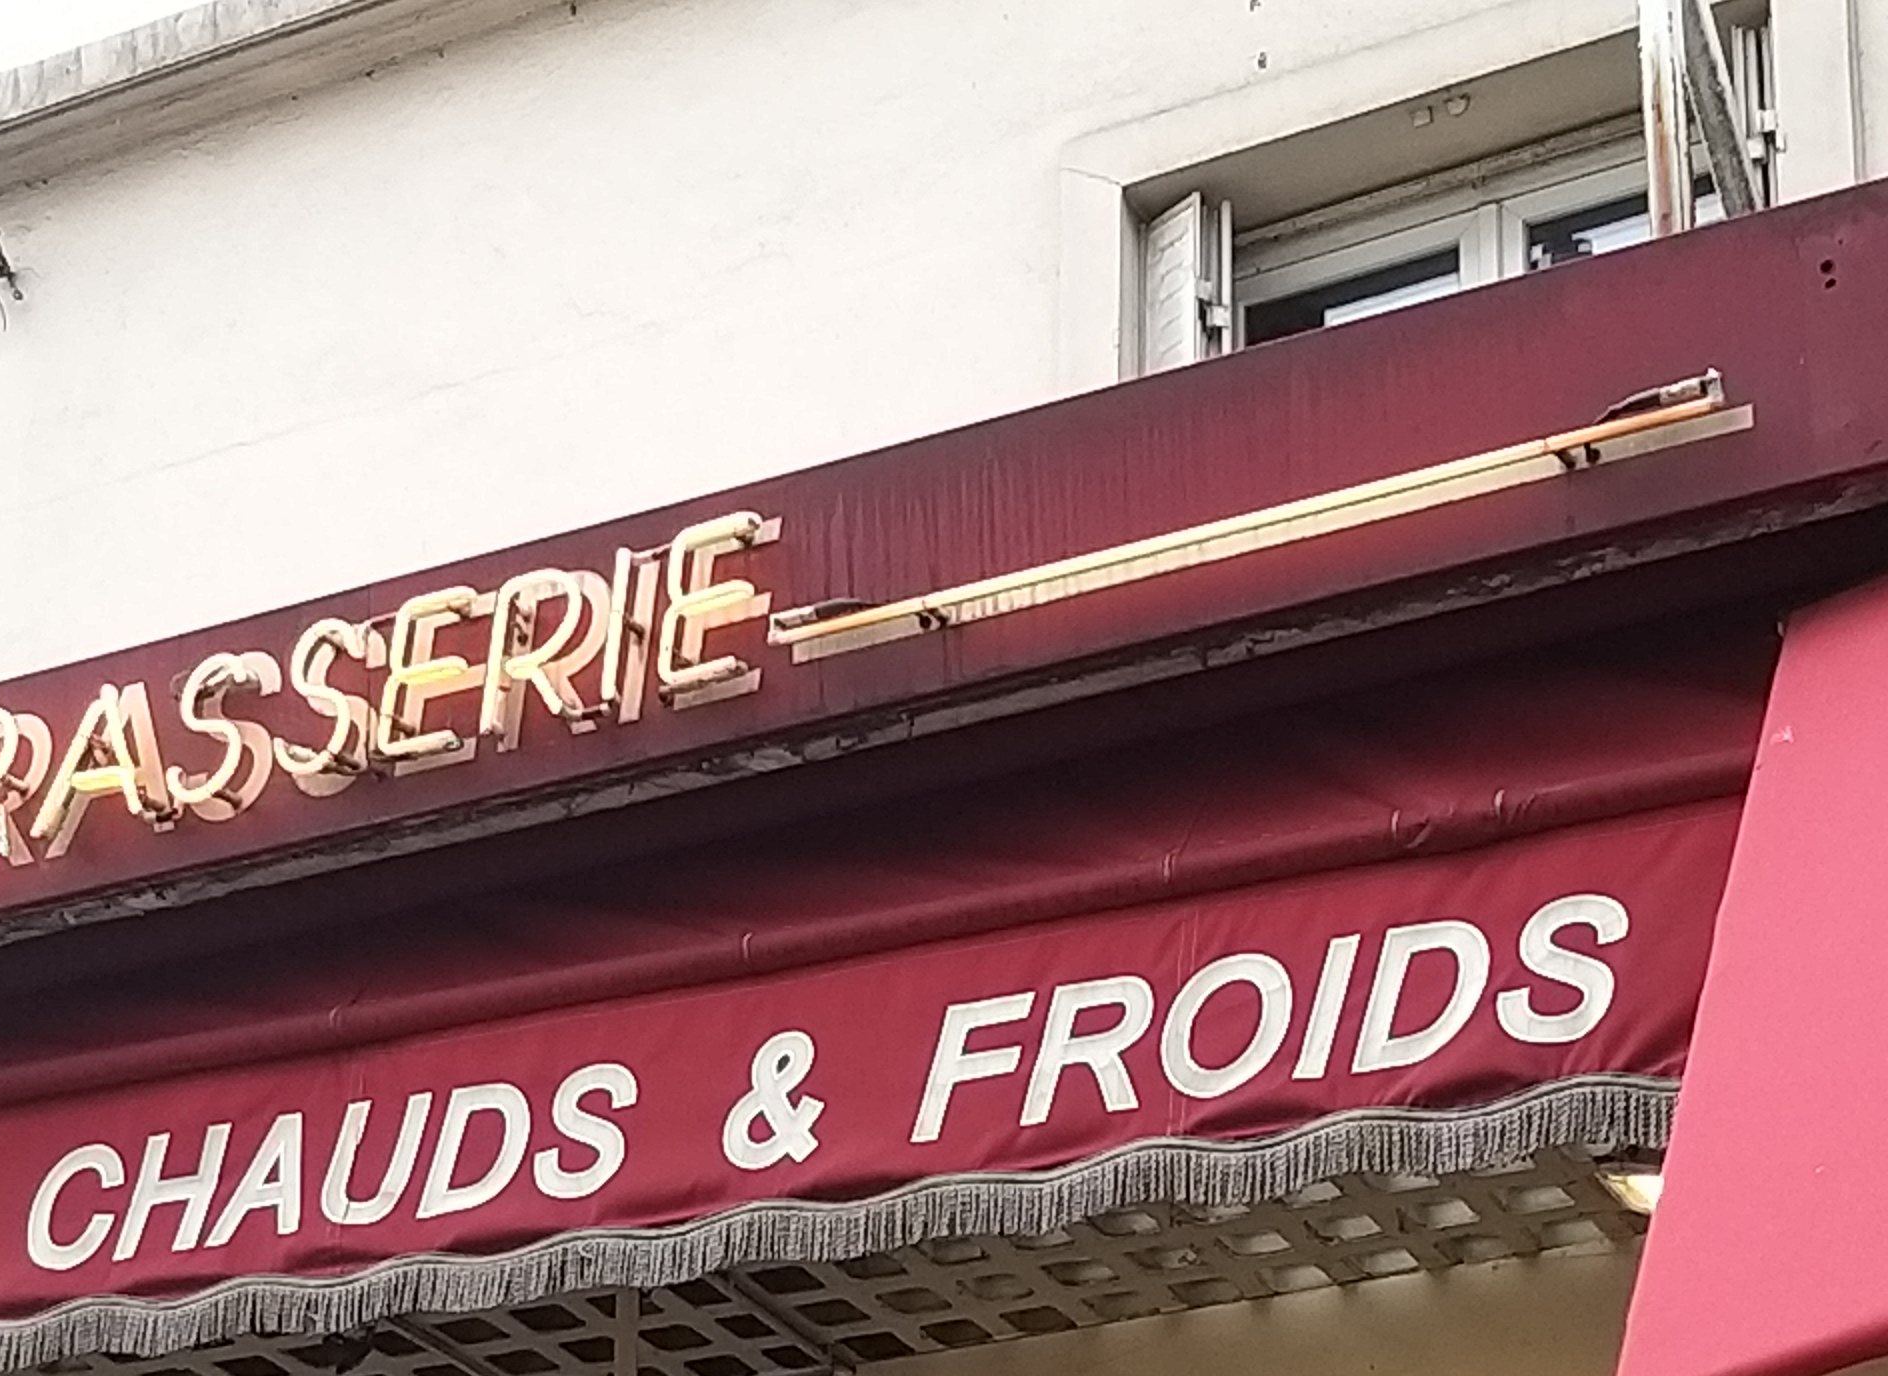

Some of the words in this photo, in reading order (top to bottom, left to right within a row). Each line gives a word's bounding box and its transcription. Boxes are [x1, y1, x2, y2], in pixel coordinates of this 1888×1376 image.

[26, 1062, 639, 1272] CHAUDS
[721, 1030, 827, 1170] &
[910, 893, 1633, 1144] FROIDS
